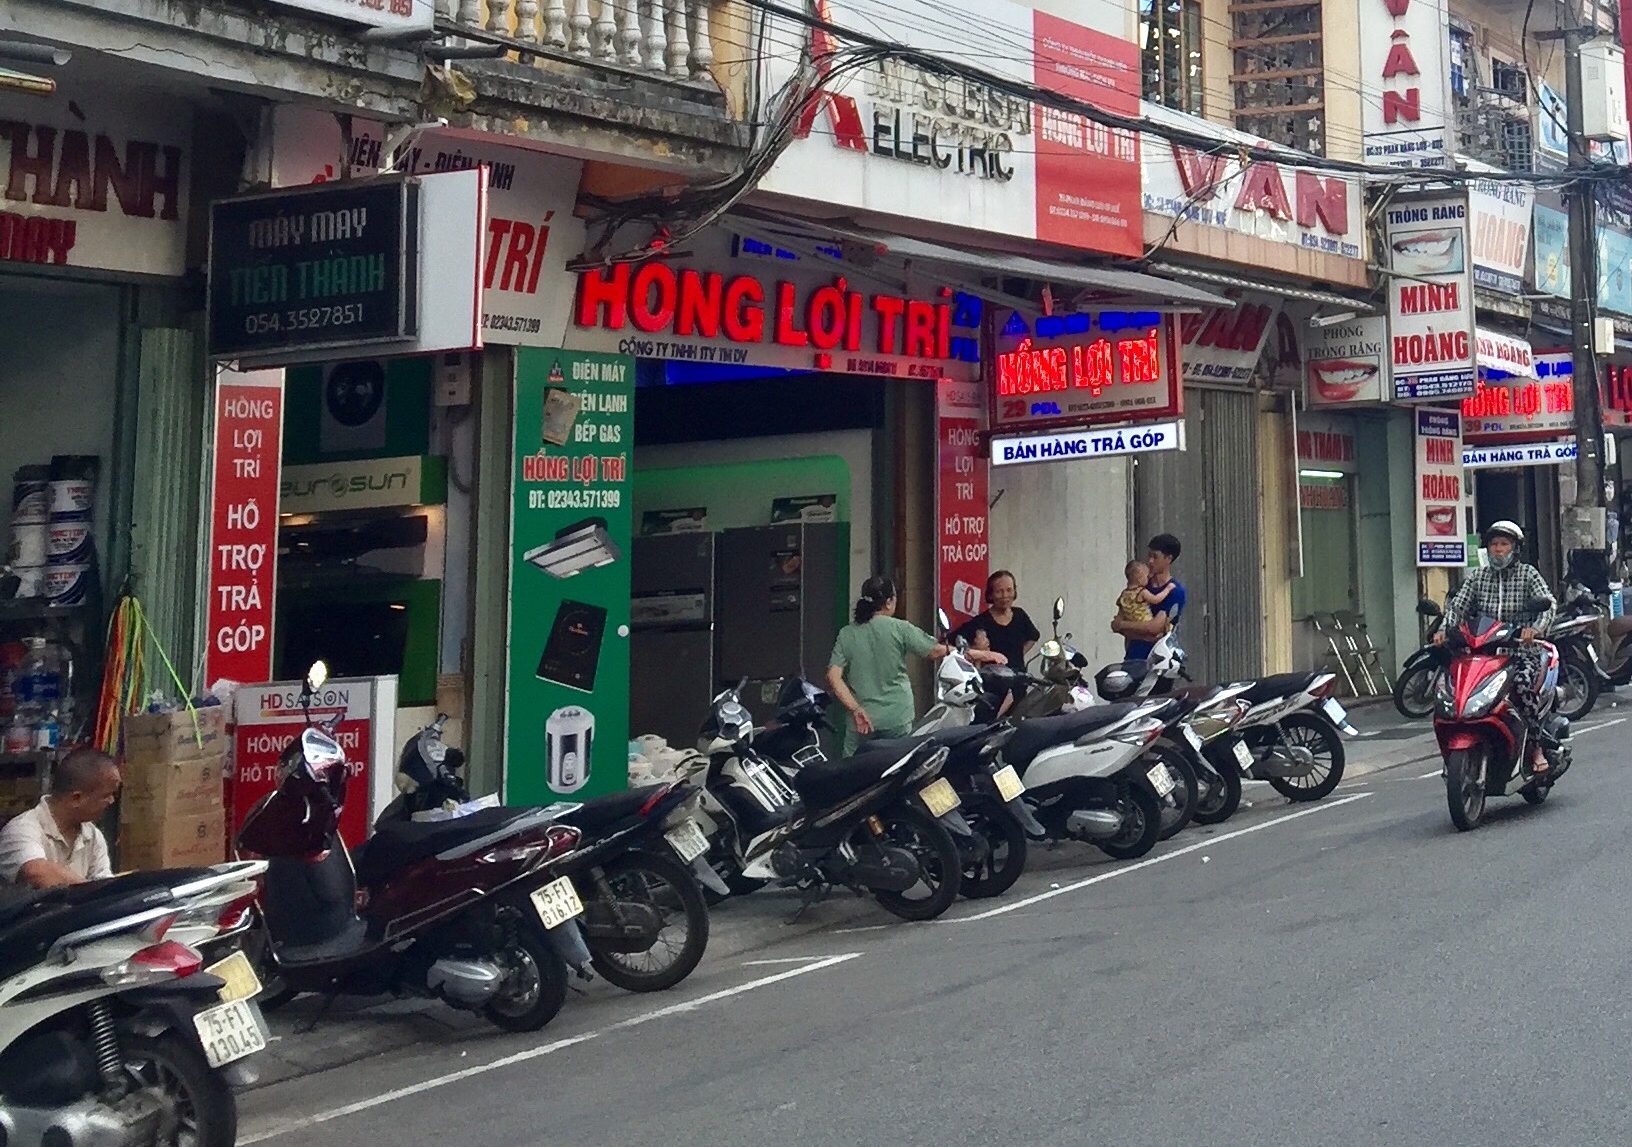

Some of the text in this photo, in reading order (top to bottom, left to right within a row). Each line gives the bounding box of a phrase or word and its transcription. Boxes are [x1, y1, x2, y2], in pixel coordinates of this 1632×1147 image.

[248, 207, 367, 250] MÁY MAY
[484, 211, 555, 294] TRÍ
[230, 251, 386, 307] TIẾN THÀNH
[1400, 282, 1458, 314] MINH
[245, 304, 365, 336] 054.3527851
[775, 276, 862, 369] LỢI
[872, 287, 952, 359] TRÍ
[998, 327, 1159, 396] HỒNG LỢI TRÍ
[1394, 326, 1469, 366] HOÀNG
[602, 358, 626, 382] MÁY
[598, 391, 628, 415] LẠNH
[233, 428, 262, 452] LỢI
[574, 419, 621, 443] BẾP GAS
[1003, 429, 1165, 461] BÁN HÀNG TRẢ GÓP
[232, 454, 260, 480] TRÍ
[523, 447, 626, 484] HỒNG LỢI TRÍ
[1426, 438, 1454, 465] MINH
[1422, 470, 1459, 501] HOÀNG
[227, 498, 259, 530] HỖ
[218, 542, 266, 575] TRỢ
[218, 578, 260, 612] TRẢ
[217, 618, 265, 653] GÓP
[538, 881, 568, 904] 75-F1
[203, 1005, 245, 1036] 75-F1
[210, 1025, 260, 1062] 130.45
